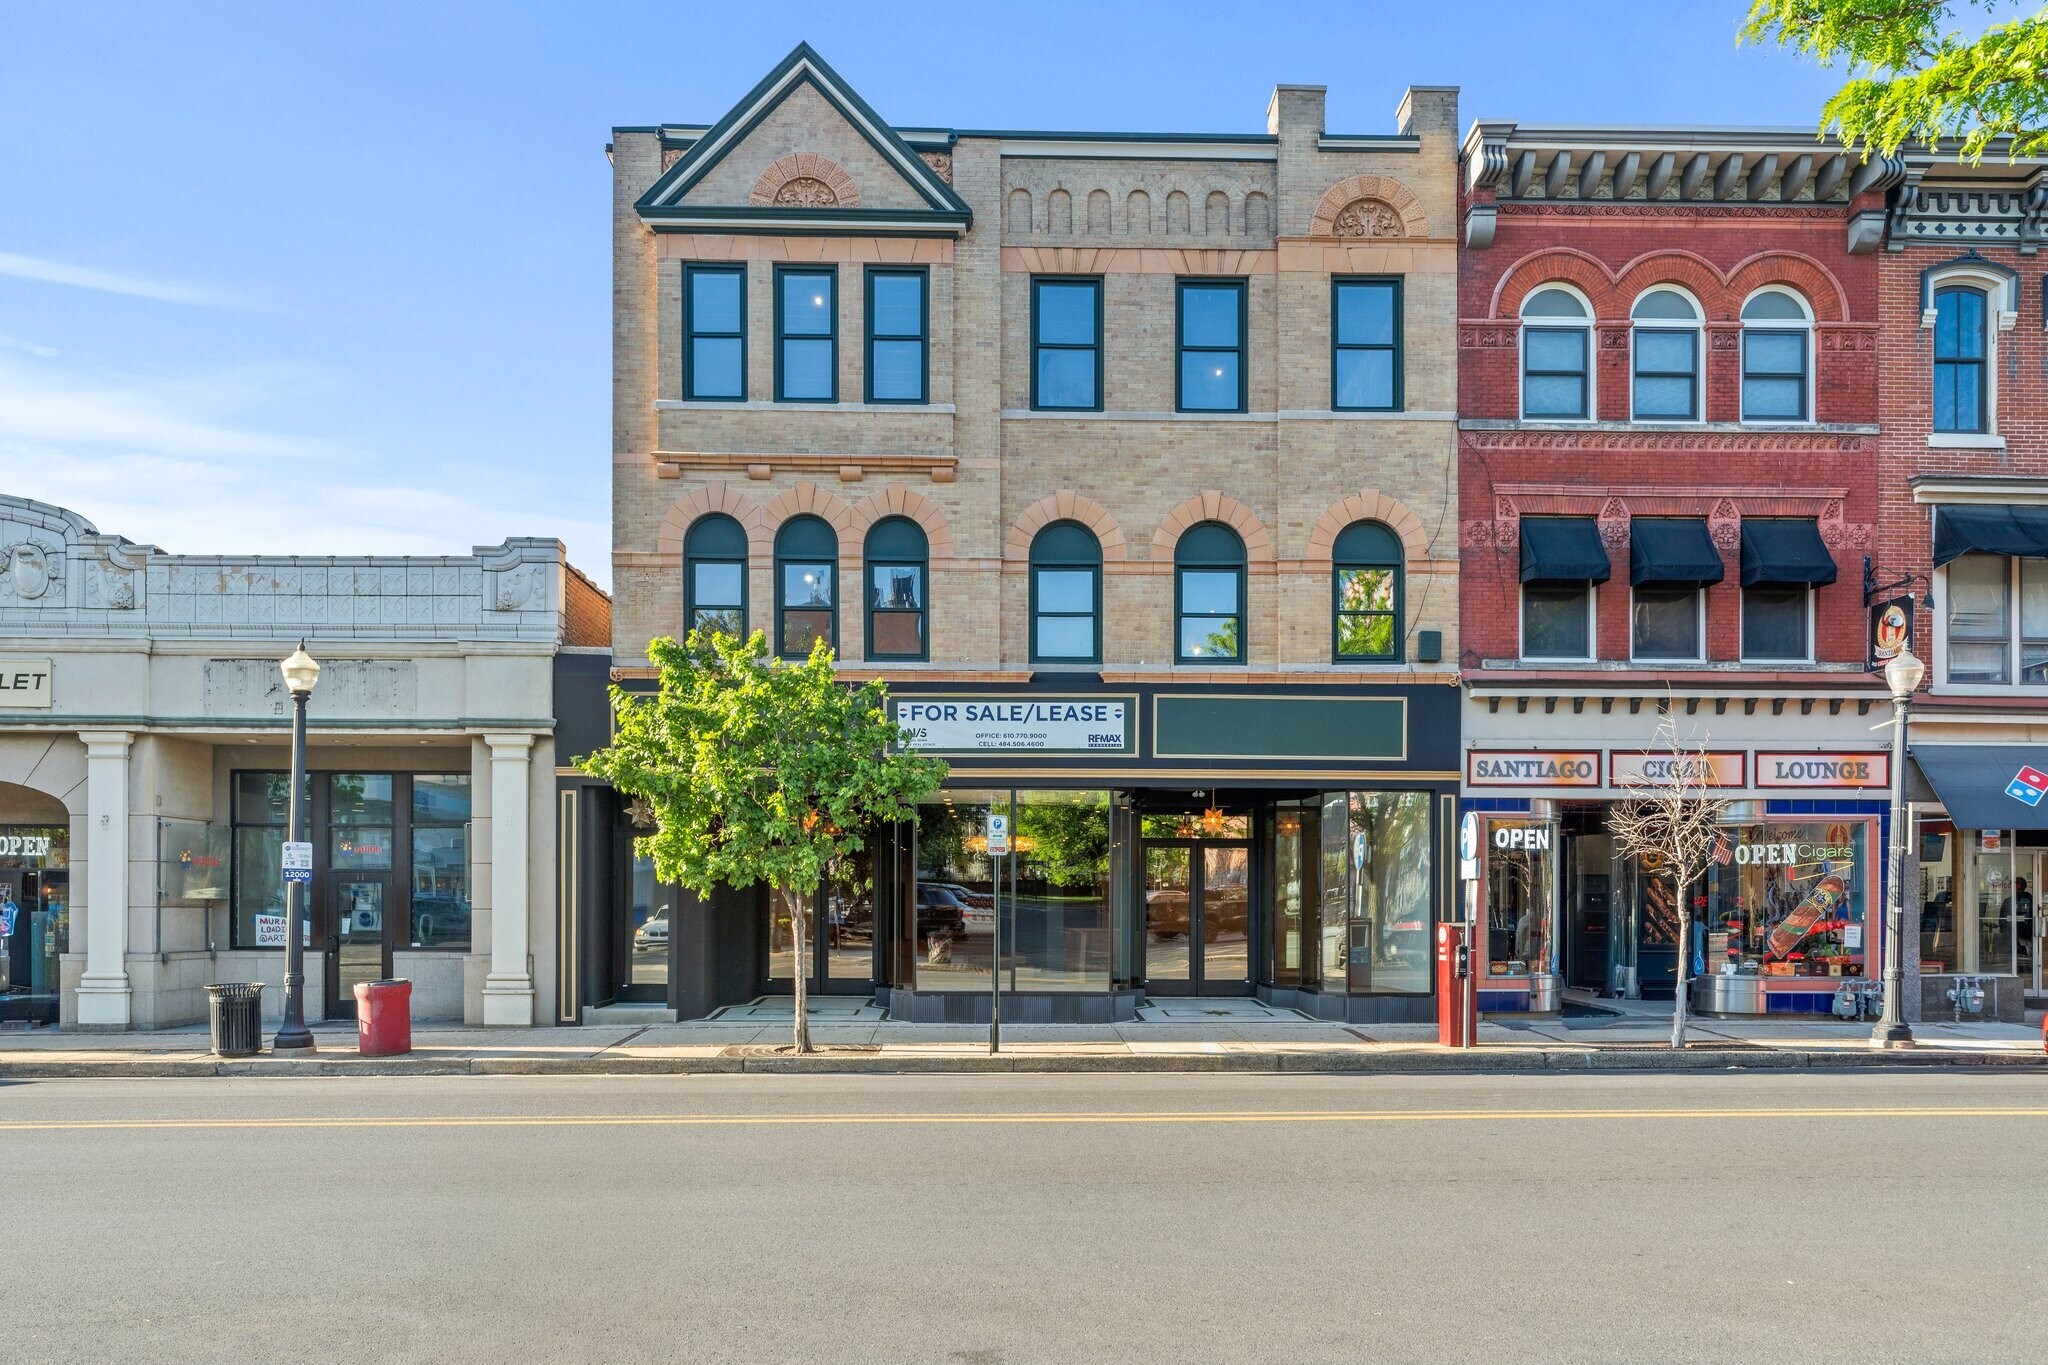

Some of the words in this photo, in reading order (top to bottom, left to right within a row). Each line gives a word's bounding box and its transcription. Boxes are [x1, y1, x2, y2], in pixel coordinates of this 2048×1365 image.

[911, 704, 958, 722] FOR
[965, 703, 1108, 725] SALE/LEASE
[1476, 760, 1593, 779] SANTIAGO
[1775, 761, 1870, 780] LOUNGE
[0, 835, 51, 856] OPEN
[1494, 828, 1550, 850] OPEN
[1734, 843, 1797, 866] OPEN
[1797, 844, 1855, 861] Cigars
[260, 918, 287, 926] MURA
[260, 925, 287, 934] LOADI
